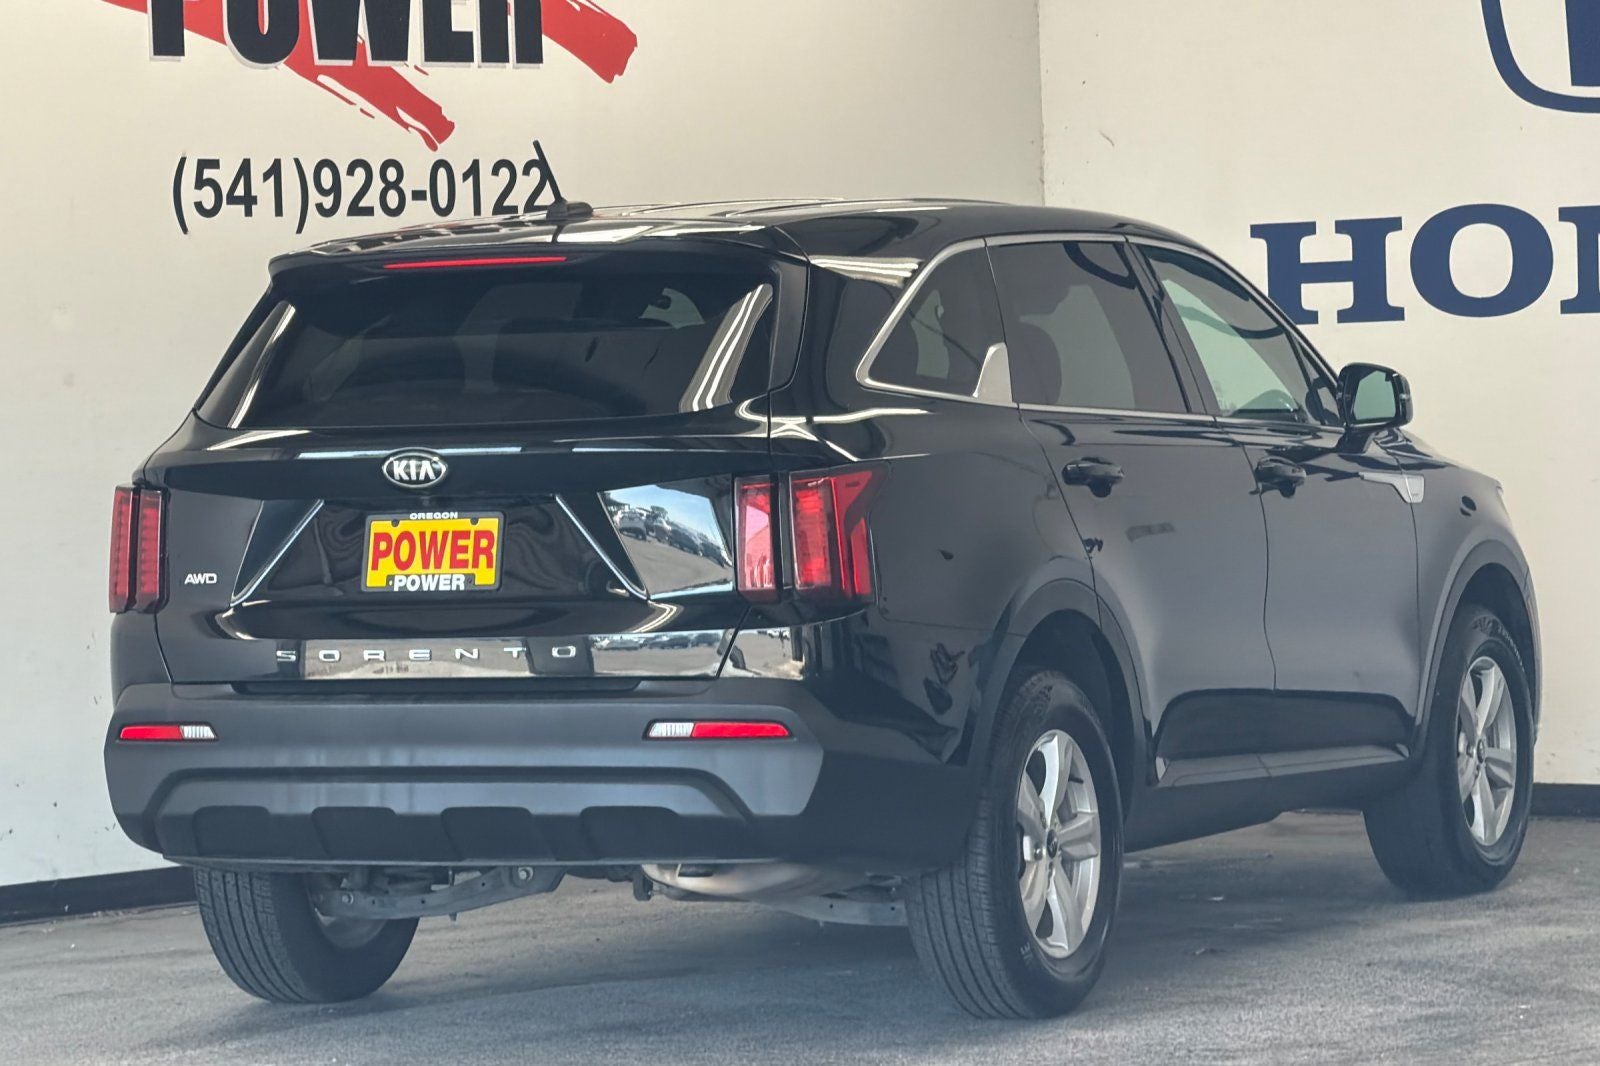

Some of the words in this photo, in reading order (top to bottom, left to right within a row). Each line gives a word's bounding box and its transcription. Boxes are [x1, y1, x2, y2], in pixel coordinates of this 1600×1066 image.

[172, 155, 548, 234] (541)928-0122
[393, 459, 436, 481] KIA
[409, 512, 458, 520] OREGON
[371, 530, 495, 571] POWER
[184, 573, 217, 584] AWD
[393, 574, 465, 591] POWER
[276, 645, 577, 662] SORENTO
